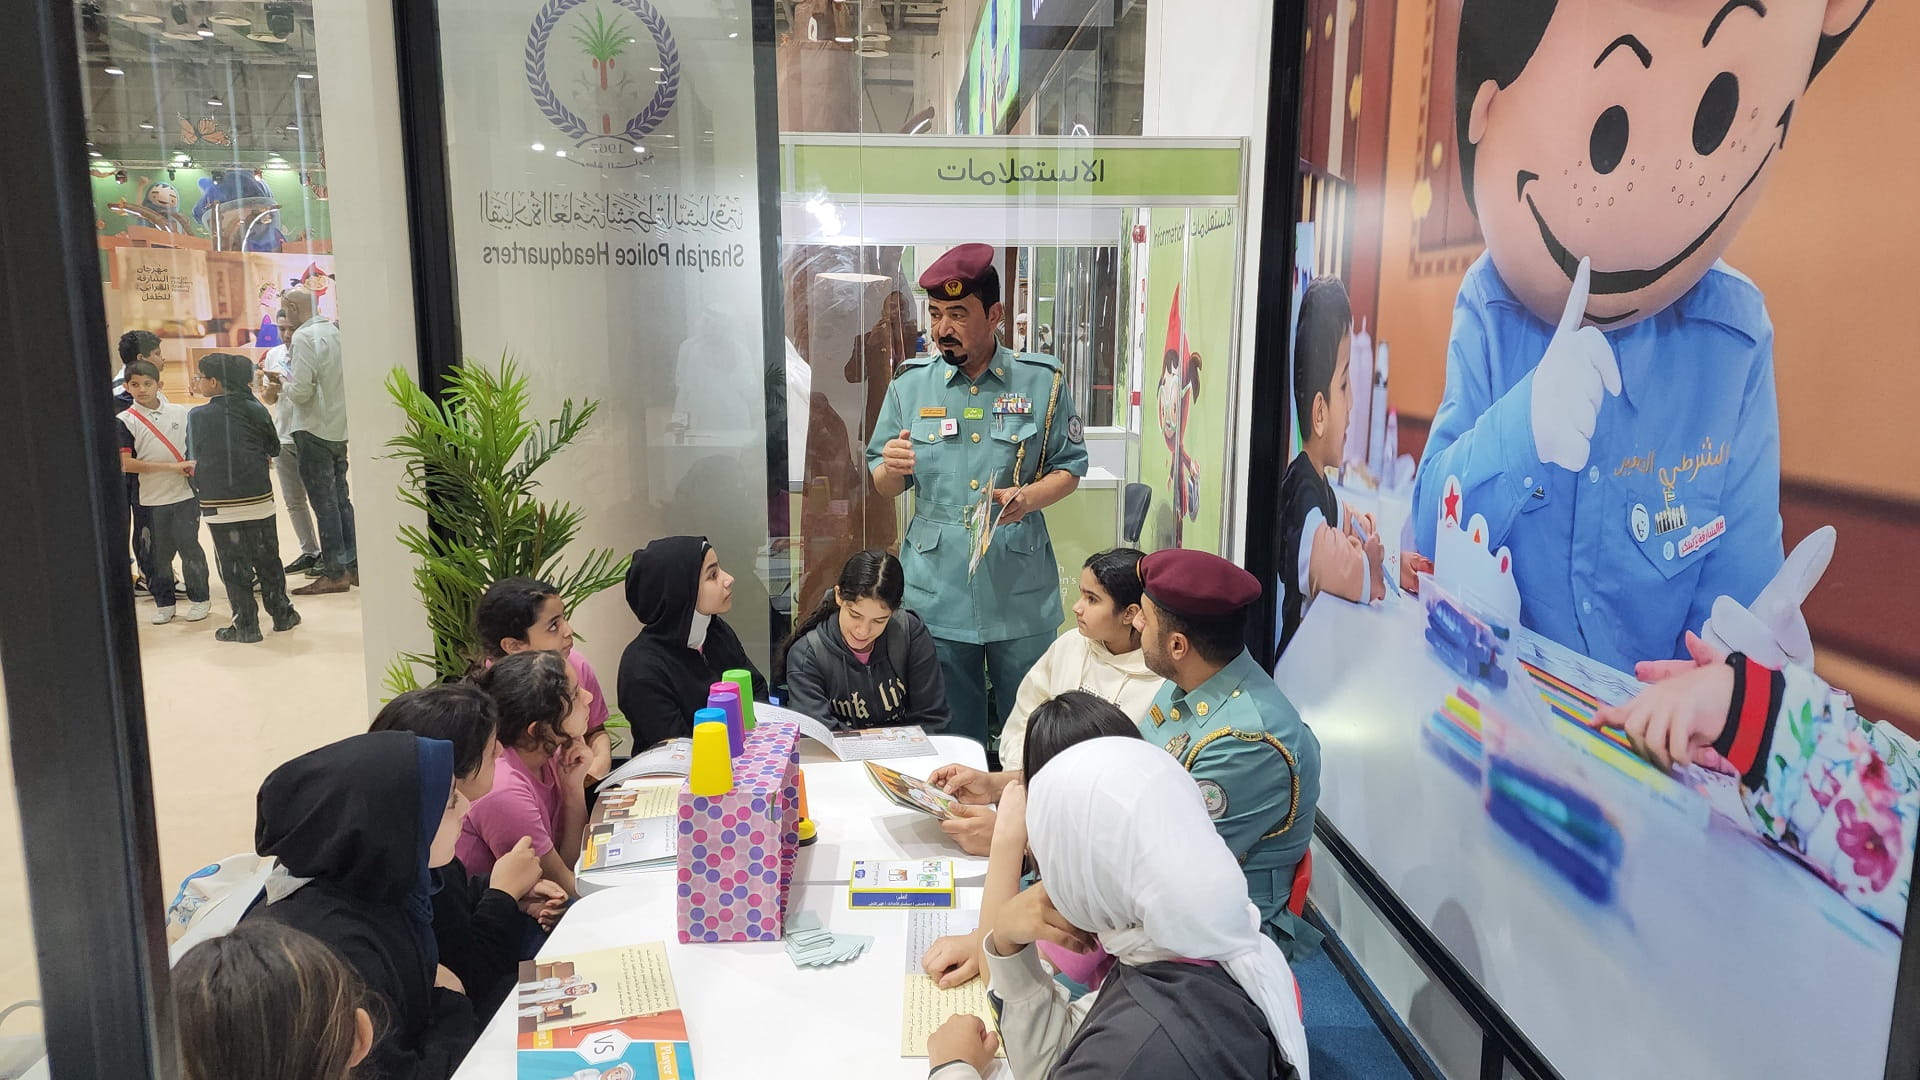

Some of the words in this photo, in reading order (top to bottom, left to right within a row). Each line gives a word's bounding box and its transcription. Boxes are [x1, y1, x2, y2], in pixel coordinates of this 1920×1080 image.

[937, 157, 1105, 187] الاستعلامات
[1659, 436, 1731, 490] الشرطي
[594, 1034, 615, 1056] VS
[659, 1045, 674, 1075] Player
